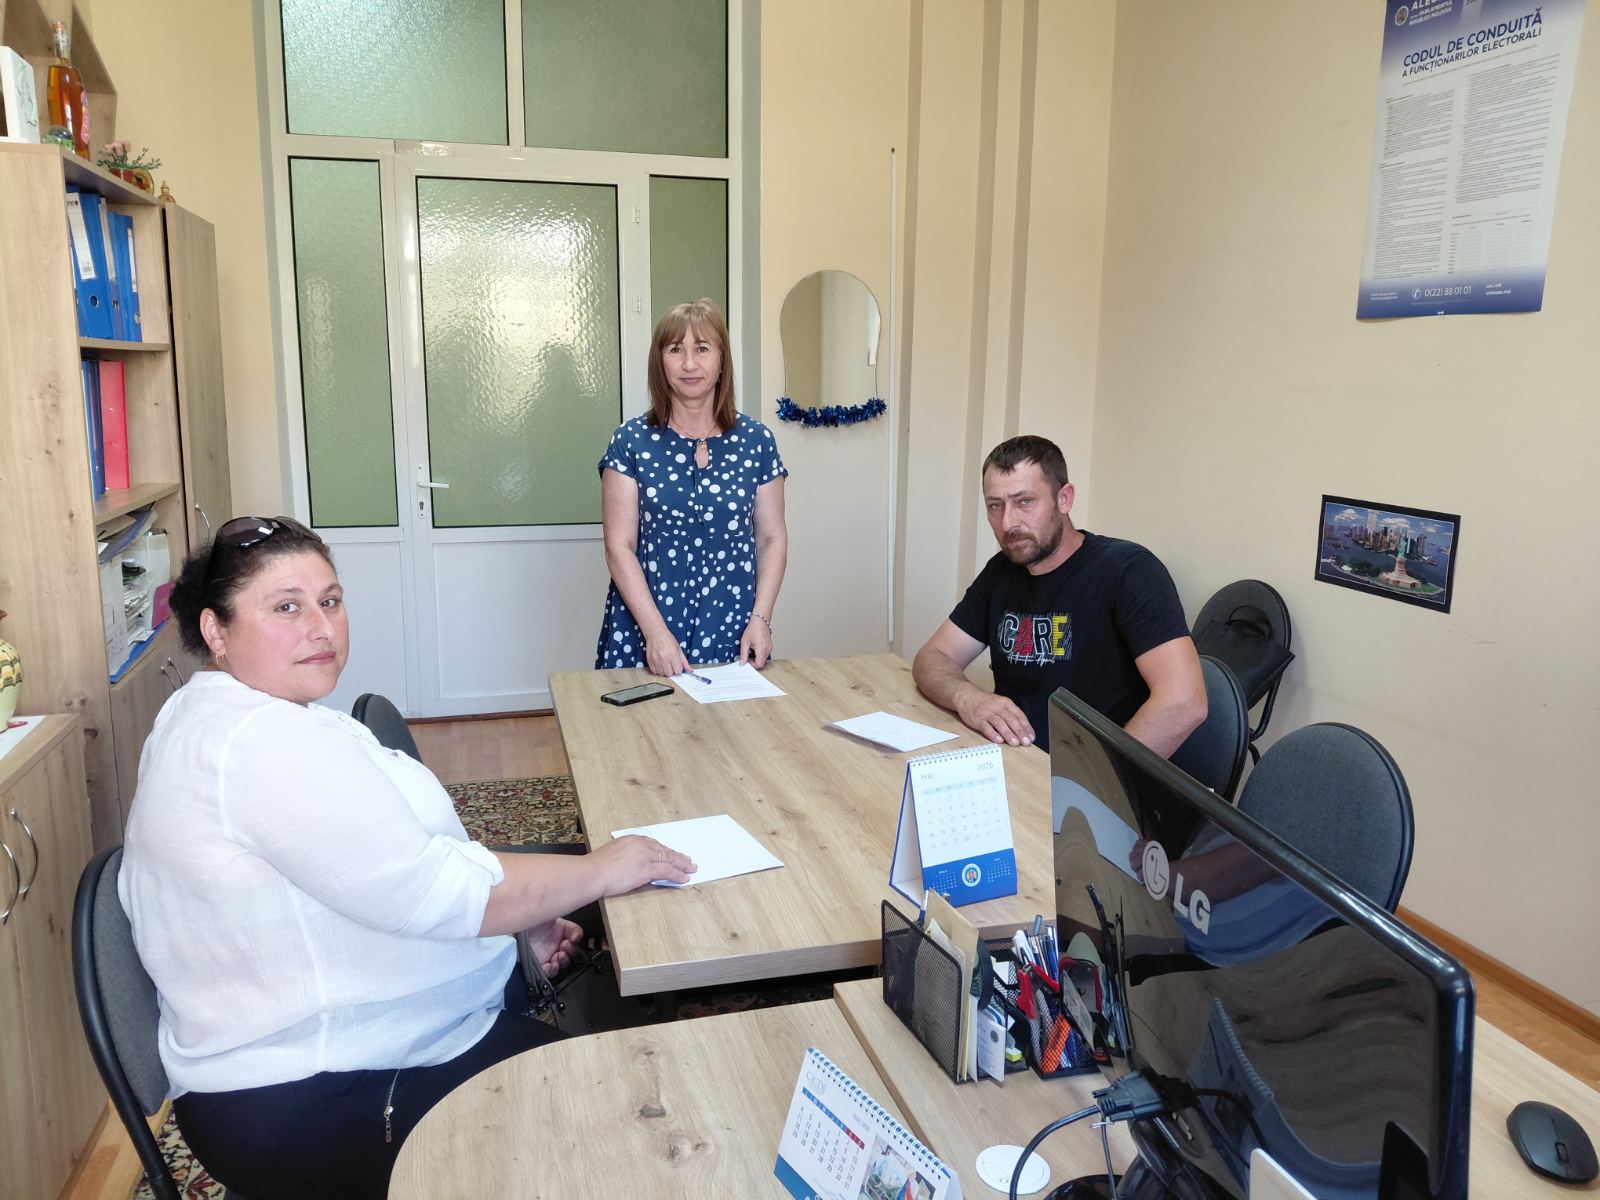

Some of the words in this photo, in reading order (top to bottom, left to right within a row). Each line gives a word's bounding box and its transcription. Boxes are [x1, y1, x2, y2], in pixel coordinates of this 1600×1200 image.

[1401, 69, 1408, 78] A
[1409, 46, 1480, 76] FUNCȚIONARILOR
[1482, 27, 1542, 53] ELECTORALI
[1403, 43, 1444, 67] CODUL
[1446, 37, 1465, 54] DE
[1467, 7, 1543, 47] CONDUITĂ
[1424, 288, 1443, 297] 0(22)
[1444, 287, 1453, 296] 88
[1454, 286, 1462, 295] 01
[1463, 285, 1472, 295] 01
[1000, 613, 1068, 656] CARE
[921, 773, 934, 781] MAI
[977, 762, 994, 770] 2026
[1173, 872, 1211, 936] LG
